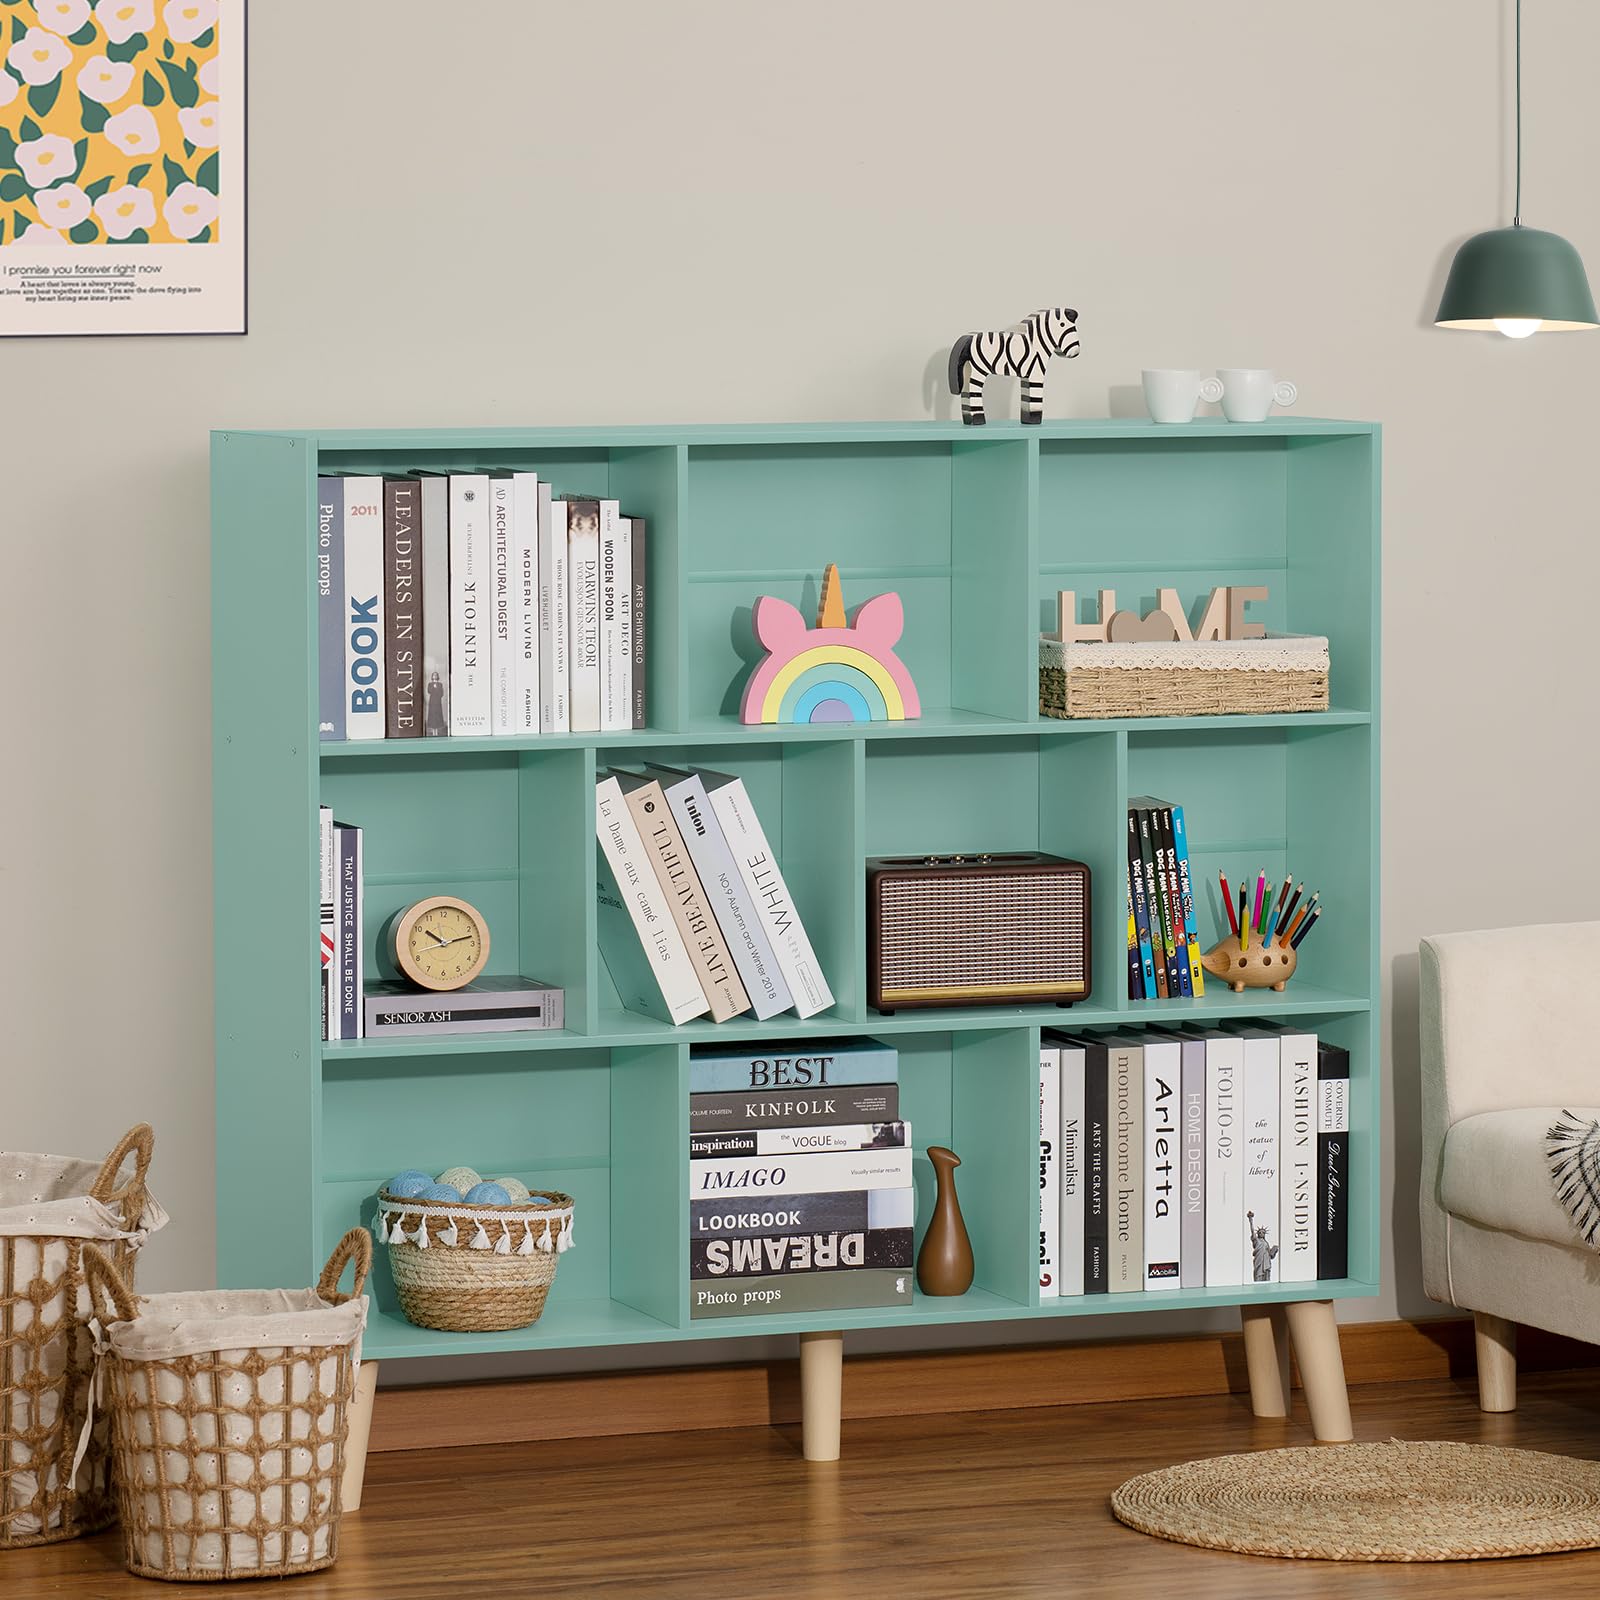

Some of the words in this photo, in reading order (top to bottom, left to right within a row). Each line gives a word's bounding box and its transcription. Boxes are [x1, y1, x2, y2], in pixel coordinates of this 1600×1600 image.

[9, 265, 50, 276] promise
[52, 266, 73, 276] you
[75, 264, 112, 274] forever
[113, 264, 136, 277] right
[138, 265, 162, 274] now
[88, 280, 111, 288] always
[495, 486, 506, 500] AD
[320, 503, 333, 547] Photo
[351, 505, 378, 516] 2011
[395, 489, 413, 603] LEADERS
[496, 505, 507, 597] ARCHITECTURAL
[604, 539, 614, 583] WOODEN
[317, 554, 330, 596] props
[523, 549, 532, 606] MODERN
[576, 561, 584, 605] EVOLUSJON
[585, 560, 597, 624] DARWINS
[542, 585, 550, 632] LIVSHJULET
[605, 586, 614, 621] SPOON
[621, 593, 629, 616] ART
[635, 584, 643, 608] ARTS
[396, 614, 413, 640] IN
[464, 581, 477, 668] KINFOLK
[497, 600, 508, 641] DIGEST
[524, 614, 532, 659] LIVING
[576, 607, 584, 645] GJENNOM
[350, 594, 378, 713] BOOK
[585, 626, 597, 668] TEORI
[621, 622, 630, 656] DECO
[636, 612, 644, 664] CHIWINGLO
[396, 651, 414, 729] STYLE
[636, 690, 644, 720] FASHION
[684, 795, 706, 837] Union
[599, 798, 611, 817] La
[608, 821, 627, 856] Dame
[623, 861, 640, 886] aux
[1156, 848, 1166, 870] DOG
[1166, 848, 1176, 870] DOG
[345, 856, 353, 882] THAT
[652, 820, 708, 934] BEAUTIFUL
[1132, 859, 1142, 876] DOG
[1145, 862, 1155, 878] DOG
[1158, 871, 1168, 892] MAN
[1169, 871, 1179, 891] MAN
[1179, 859, 1189, 876] DOG
[747, 851, 793, 936] WHITE
[1134, 878, 1144, 893] MAN
[1147, 879, 1156, 894] MAN
[1181, 878, 1191, 894] MAN
[345, 885, 353, 927] JUSTICE
[345, 933, 353, 966] SHALL
[717, 872, 734, 895] NO.9
[728, 897, 747, 931] Autumn
[742, 930, 753, 950] and
[751, 946, 767, 977] Winter
[761, 977, 777, 1000] 2018
[345, 969, 353, 983] BE
[698, 936, 729, 985] LIVE
[345, 986, 353, 1014] DONE
[383, 1011, 426, 1025] SENIOR
[427, 1010, 451, 1023] ASH
[749, 1056, 835, 1088] BEST
[745, 1100, 836, 1118] KINFOLK
[1117, 1056, 1134, 1183] monochrome
[1187, 1093, 1200, 1144] HOME
[1217, 1066, 1233, 1159] FOLIO-02
[1294, 1061, 1309, 1147] FASHION
[1324, 1081, 1333, 1129] COMMUTE
[1335, 1080, 1344, 1130] COVERING
[1093, 1122, 1102, 1148] ARTS
[1248, 1136, 1274, 1144] statue
[1254, 1119, 1268, 1128] the
[691, 1137, 754, 1154] inspiration
[792, 1135, 832, 1147] VOGUE
[1065, 1119, 1079, 1196] Minimalista
[1093, 1151, 1101, 1172] THE
[1155, 1077, 1175, 1219] Arletta
[1256, 1150, 1268, 1163] of
[700, 1167, 786, 1190] IMAGO
[1248, 1166, 1275, 1179] liberty
[1092, 1174, 1101, 1215] CRAFTS
[698, 1210, 801, 1231] LOOKBOOK
[1117, 1188, 1135, 1242] home
[706, 1232, 865, 1275] DREAMS
[696, 1290, 738, 1305] Photo
[743, 1289, 782, 1305] props
